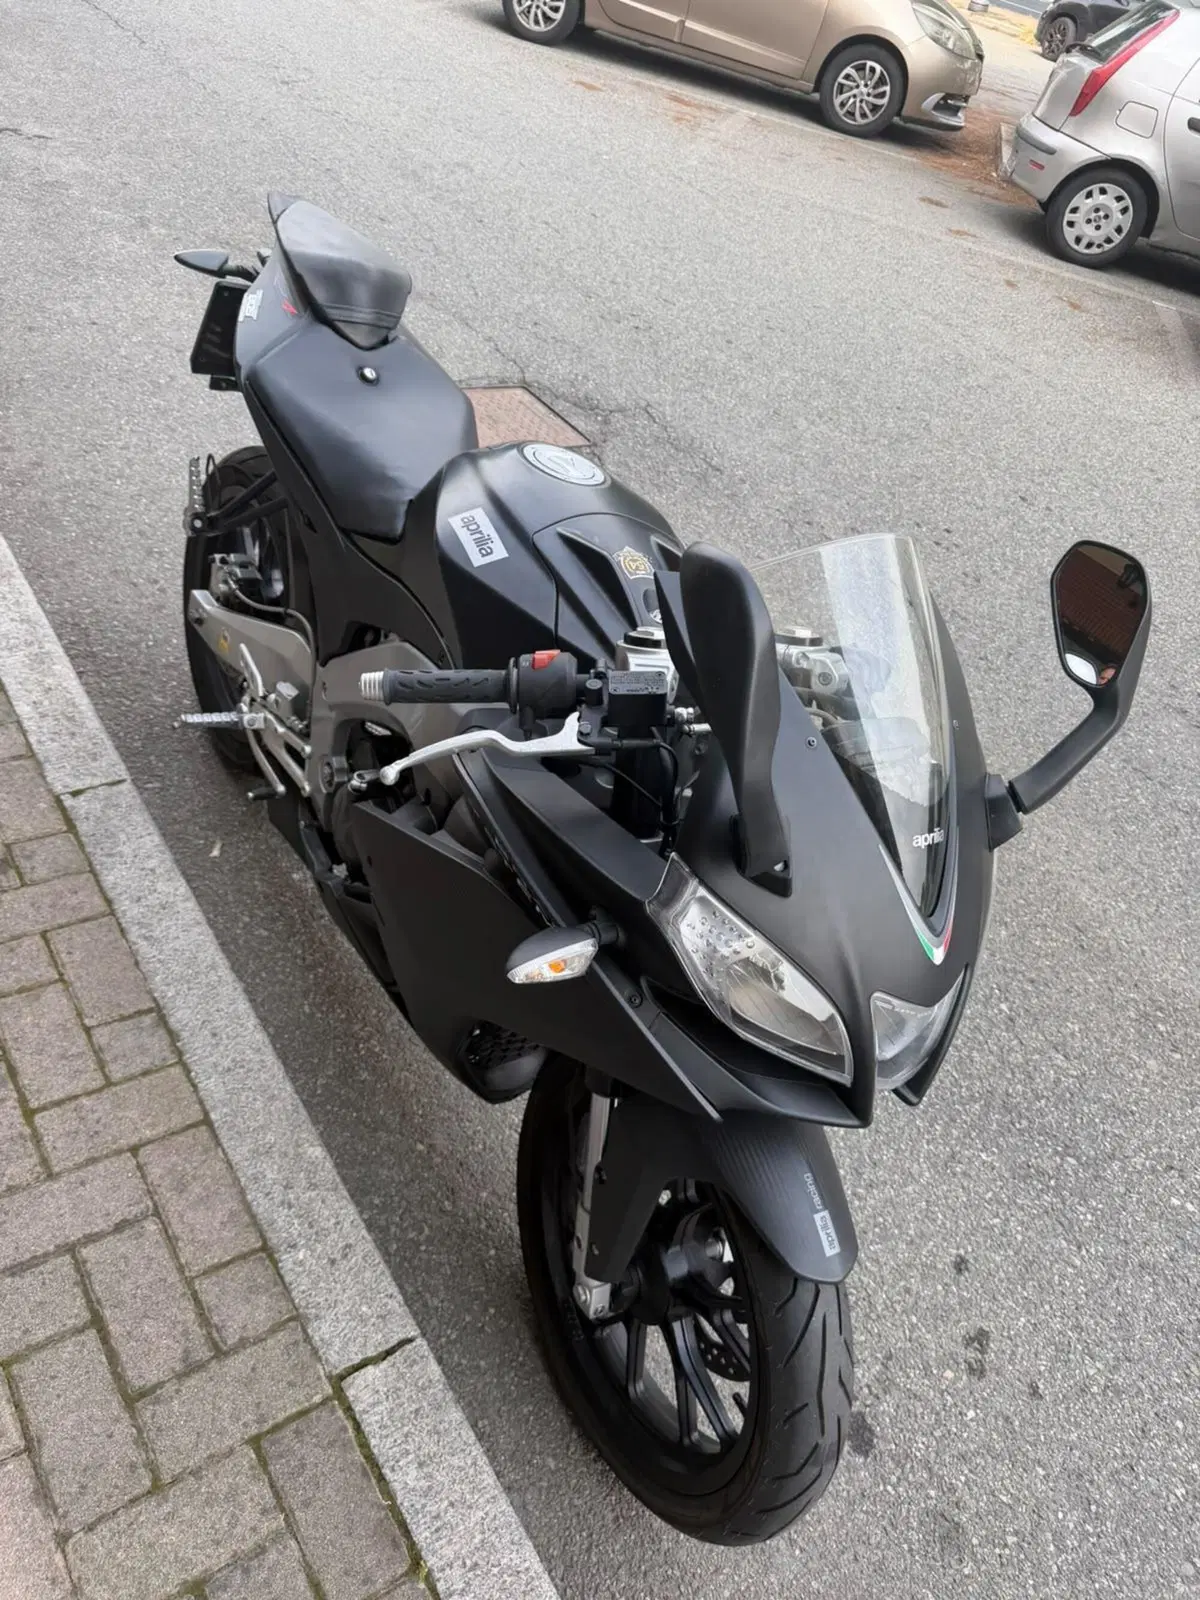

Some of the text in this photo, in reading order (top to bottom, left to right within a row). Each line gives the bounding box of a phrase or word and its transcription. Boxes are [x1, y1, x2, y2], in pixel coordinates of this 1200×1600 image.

[460, 515, 494, 558] aprilia
[804, 1172, 836, 1251] aprilia racing
